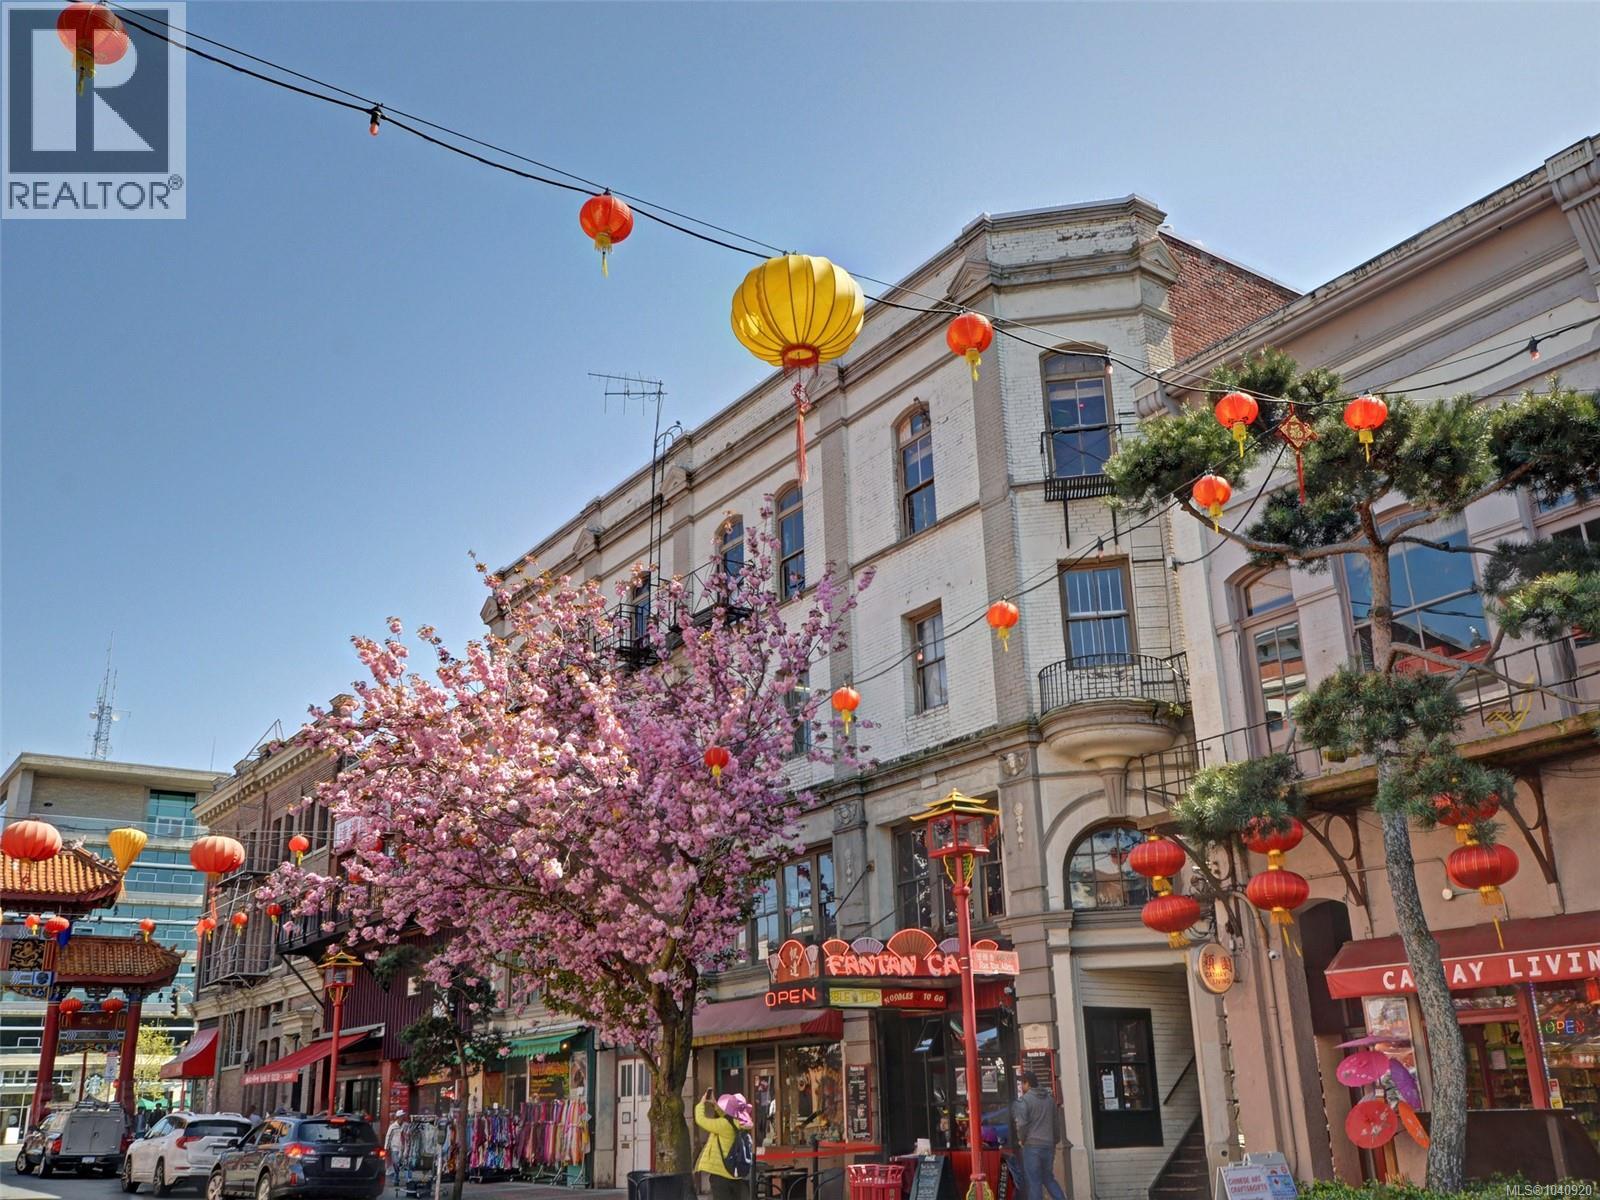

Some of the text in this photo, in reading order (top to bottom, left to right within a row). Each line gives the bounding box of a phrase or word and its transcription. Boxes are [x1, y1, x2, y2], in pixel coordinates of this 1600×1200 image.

[1382, 960, 1484, 991] CAAY
[765, 986, 817, 1007] OPEN
[884, 992, 944, 1005] NOODLES TO GO
[1545, 1019, 1585, 1035] OPEN
